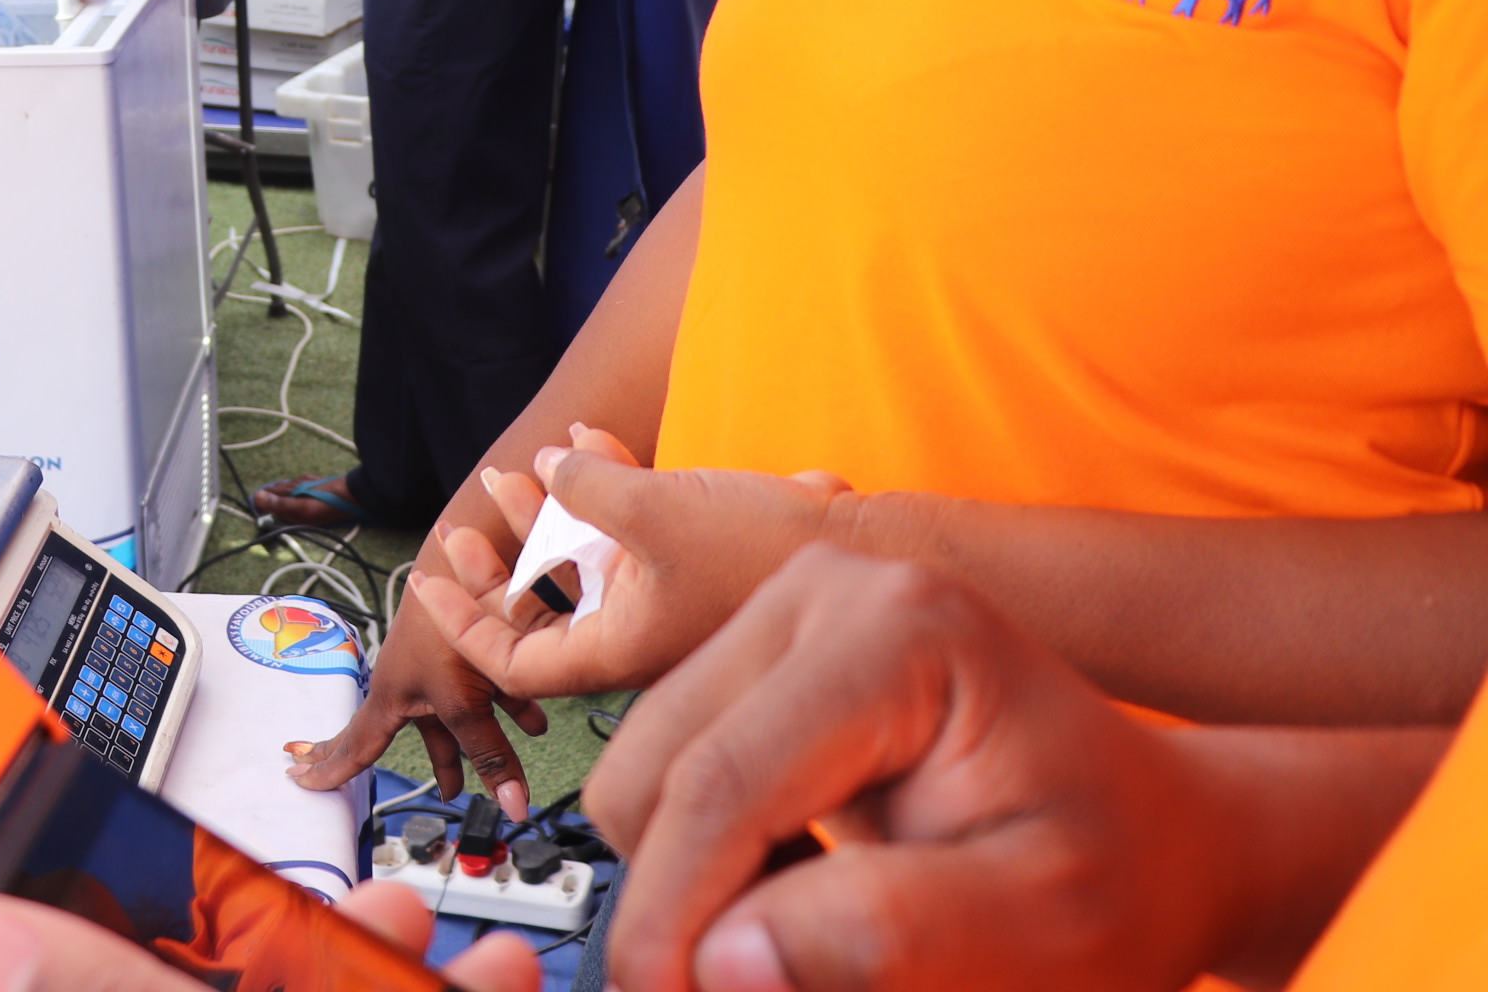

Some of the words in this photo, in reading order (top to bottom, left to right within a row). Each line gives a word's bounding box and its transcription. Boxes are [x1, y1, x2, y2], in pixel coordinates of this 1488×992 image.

[37, 555, 49, 571] Amount
[10, 610, 21, 625] PRICE
[106, 630, 114, 638] 9
[100, 644, 109, 653] 8
[129, 647, 138, 655] 6
[229, 630, 283, 668] NAMIBIA'S
[93, 658, 102, 667] 7
[123, 661, 132, 669] 5
[152, 663, 161, 672] 3
[147, 677, 156, 686] 2
[135, 707, 144, 716] 0
